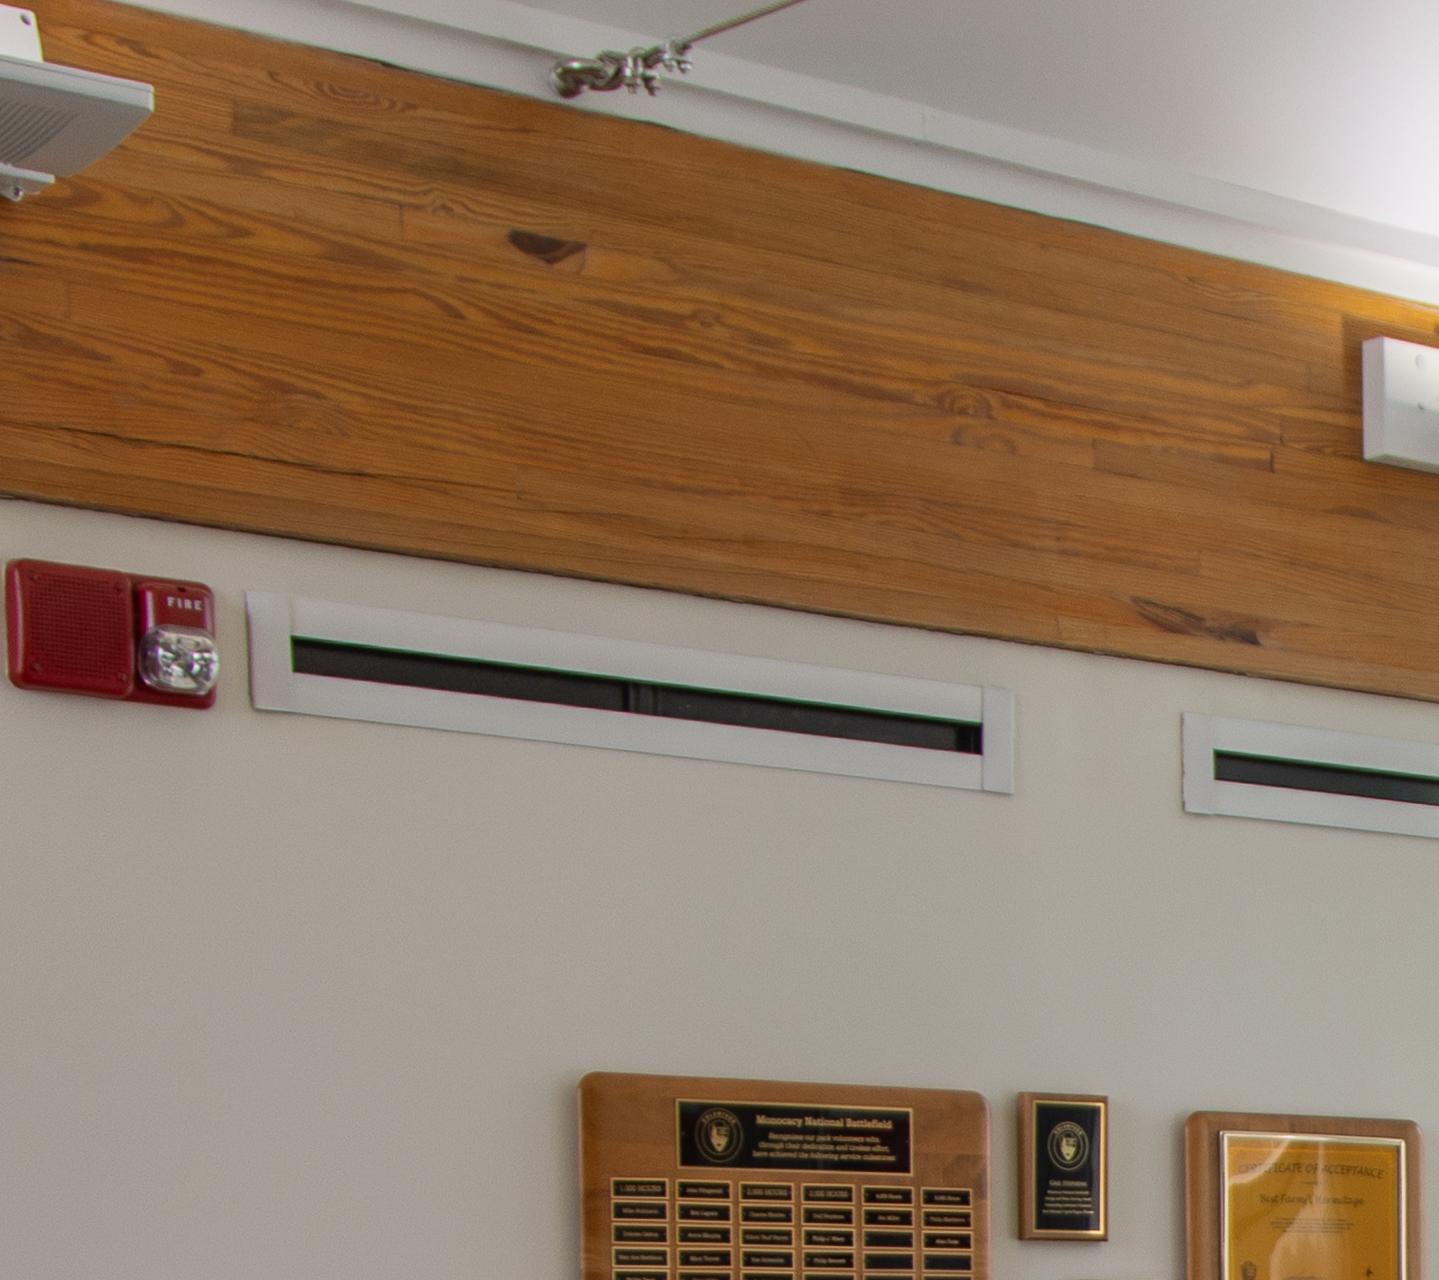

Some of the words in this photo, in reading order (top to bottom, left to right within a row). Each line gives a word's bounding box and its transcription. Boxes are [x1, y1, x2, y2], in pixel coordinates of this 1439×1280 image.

[166, 596, 202, 611] FIRE
[755, 1114, 803, 1127] Monocacy
[804, 1116, 844, 1127] National
[846, 1118, 893, 1129] Battlefield
